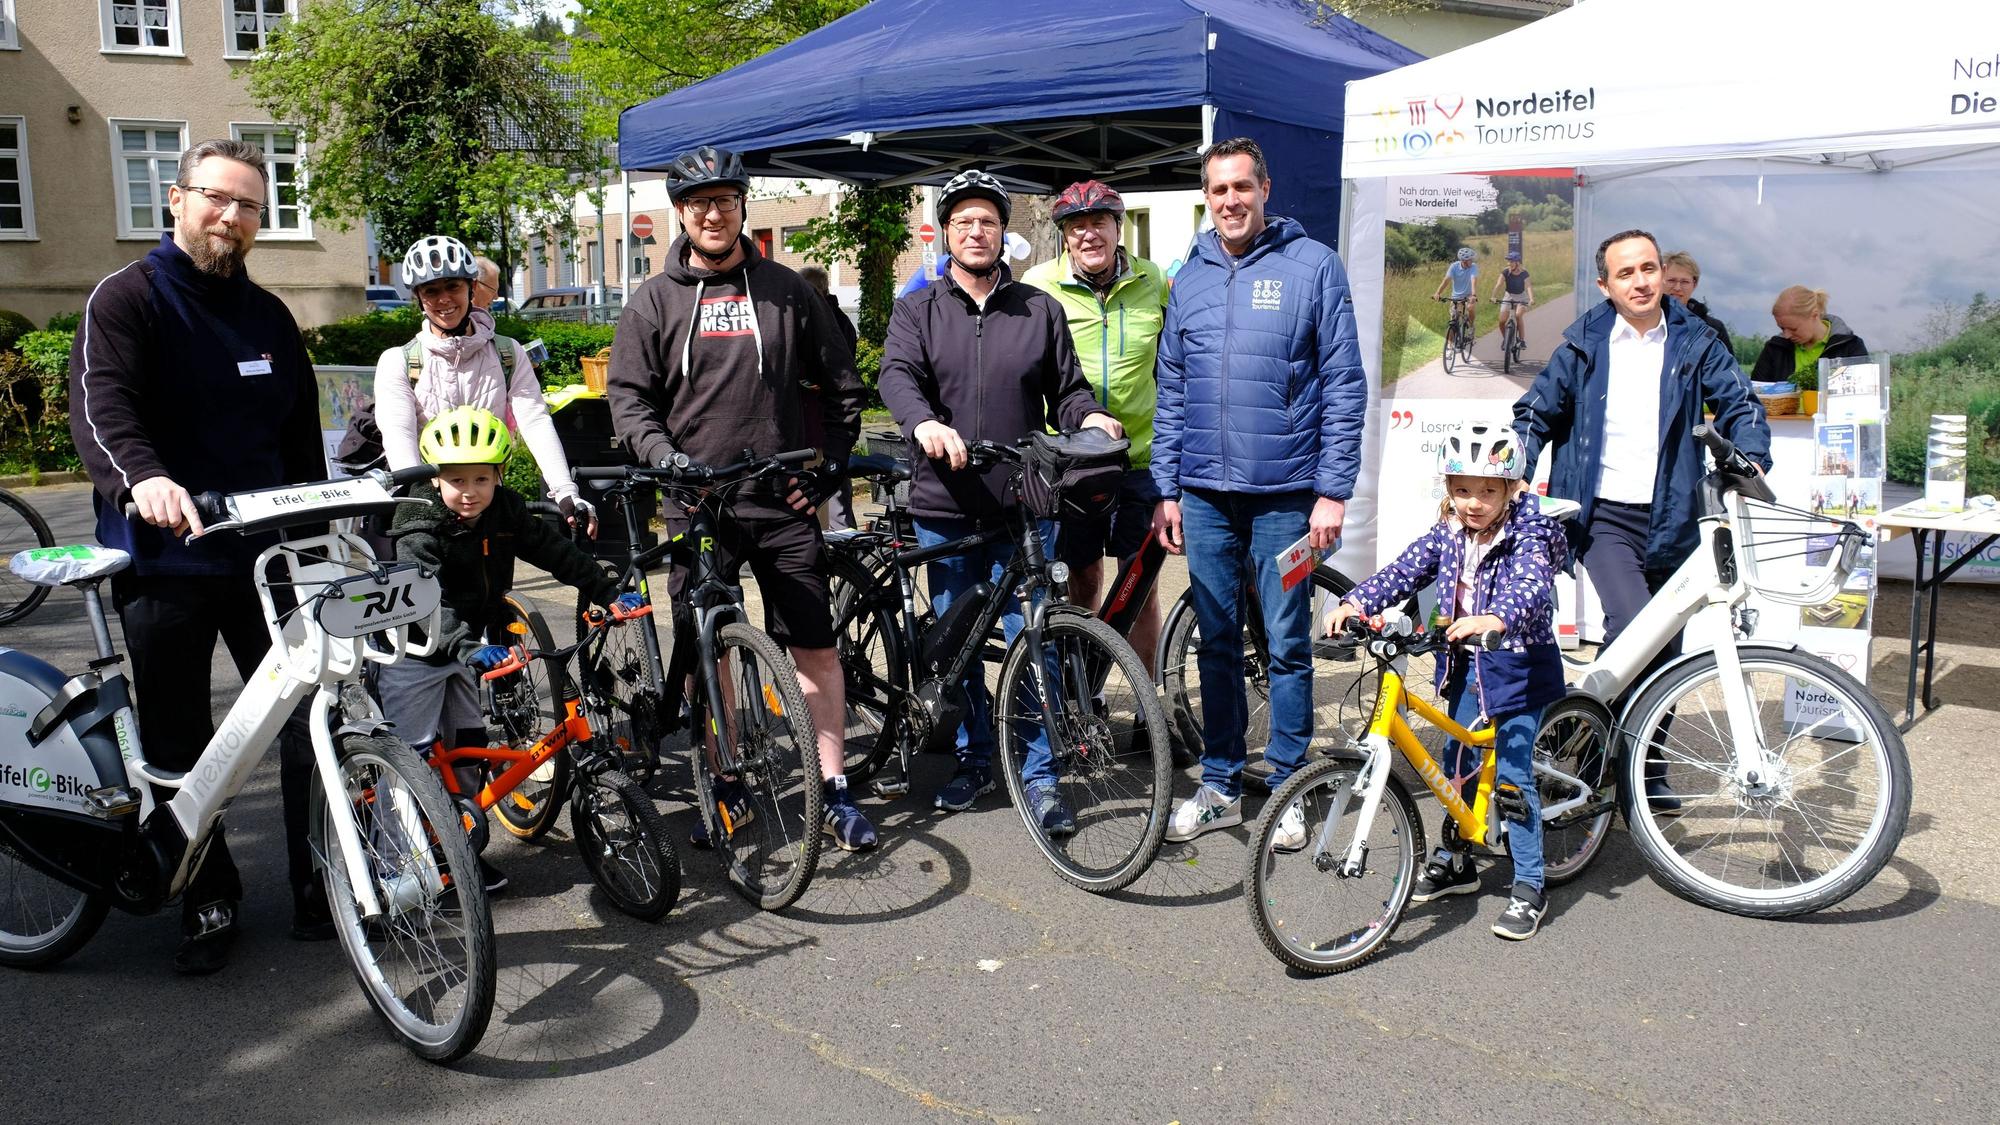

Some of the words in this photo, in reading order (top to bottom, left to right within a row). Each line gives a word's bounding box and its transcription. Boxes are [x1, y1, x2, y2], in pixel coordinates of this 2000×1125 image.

[1476, 87, 1595, 119] Nordeifel
[1951, 91, 1997, 114] Die
[1474, 121, 1595, 145] Tourismus
[1399, 186, 1417, 195] Nah
[1419, 187, 1440, 196] dran.
[1443, 187, 1462, 196] Weit
[1463, 188, 1485, 198] weg!
[1399, 198, 1413, 207] Die
[1415, 199, 1458, 208] Nordeifel
[701, 301, 751, 318] BRGR
[700, 316, 752, 332] MSTR
[272, 494, 305, 506] Eifel
[701, 537, 713, 553] R
[1119, 572, 1137, 602] VICTORIA
[1373, 684, 1390, 722] woom
[114, 716, 133, 761] 530614
[193, 702, 261, 799] nextbike
[1419, 758, 1466, 813] woom
